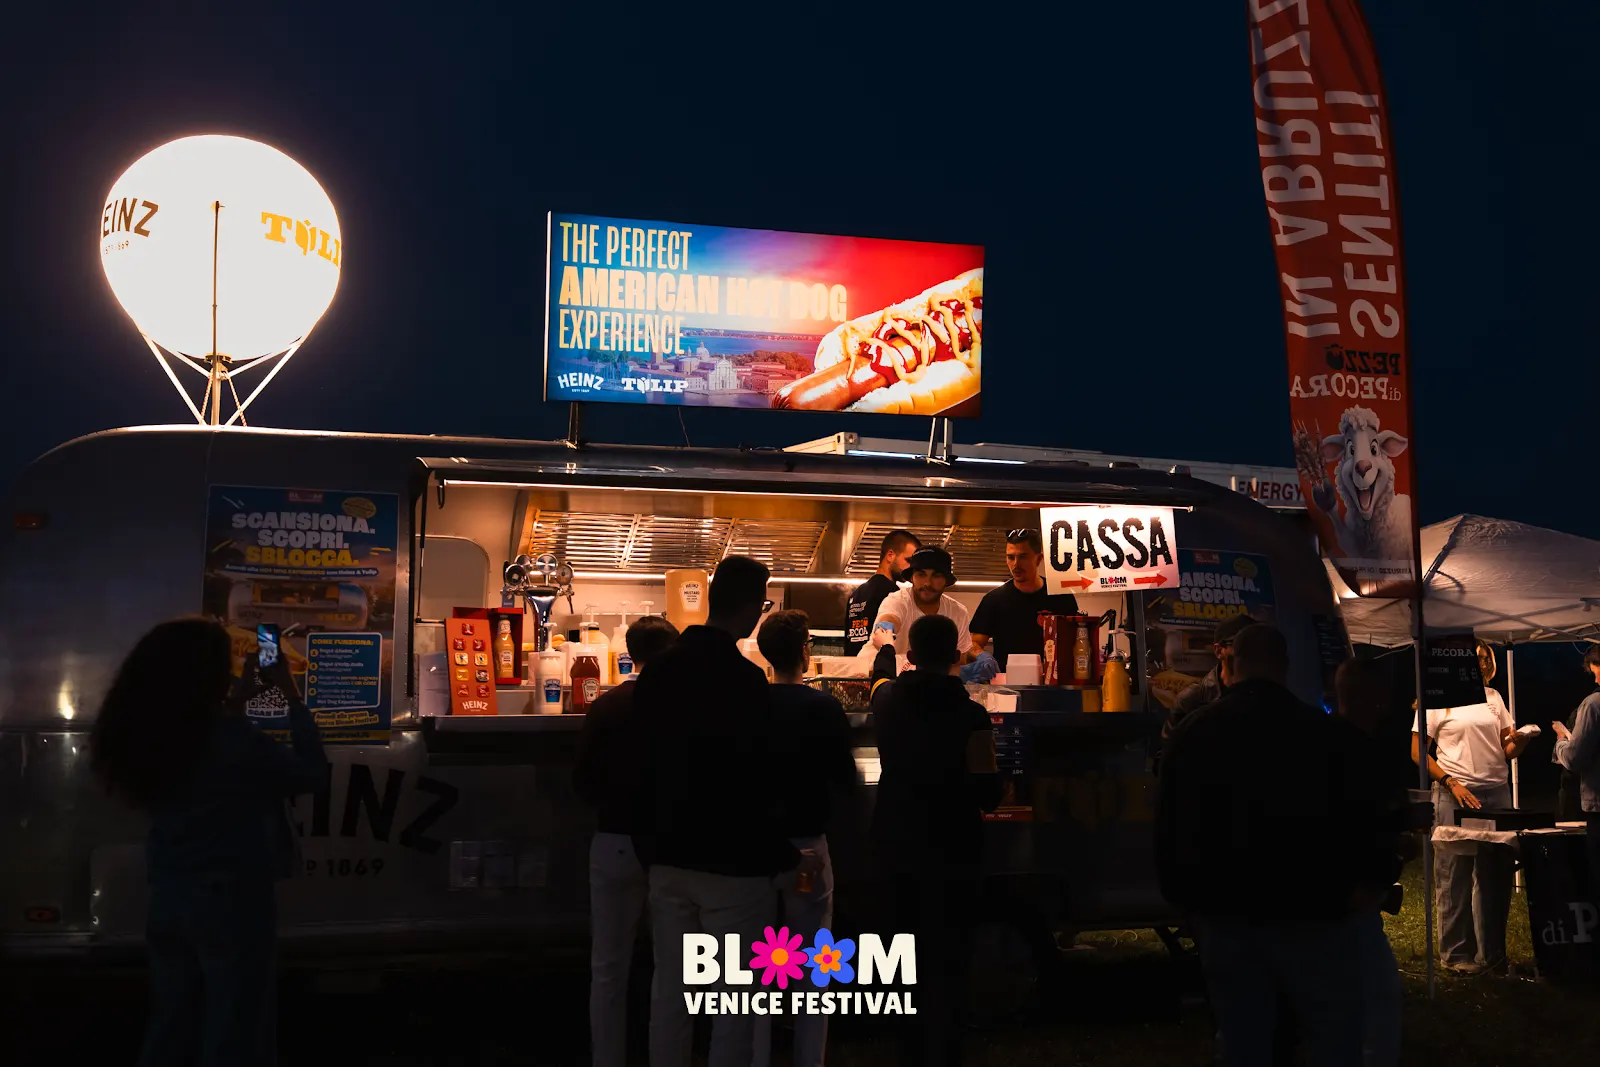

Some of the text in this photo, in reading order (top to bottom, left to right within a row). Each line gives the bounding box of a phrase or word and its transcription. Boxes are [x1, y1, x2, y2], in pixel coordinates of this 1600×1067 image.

[560, 222, 692, 270] THE PERFECT
[559, 266, 847, 322] AMERICAN HOT DOG
[559, 309, 685, 354] EXPERIENCE
[557, 372, 604, 390] HEINZ
[621, 376, 689, 394] TULIP
[232, 511, 376, 535] SCANSIONA.
[257, 529, 350, 549] SCOPRI.
[1050, 516, 1173, 572] CASSA
[246, 546, 359, 568] SBLOCCA.
[1180, 572, 1260, 593] ANSIONA.
[1180, 587, 1244, 604] SCOPRI.
[1431, 647, 1475, 657] PECORA
[462, 700, 488, 710] HEINZ
[290, 763, 459, 854] INZ
[327, 857, 385, 877] 1869
[1541, 917, 1572, 946] di
